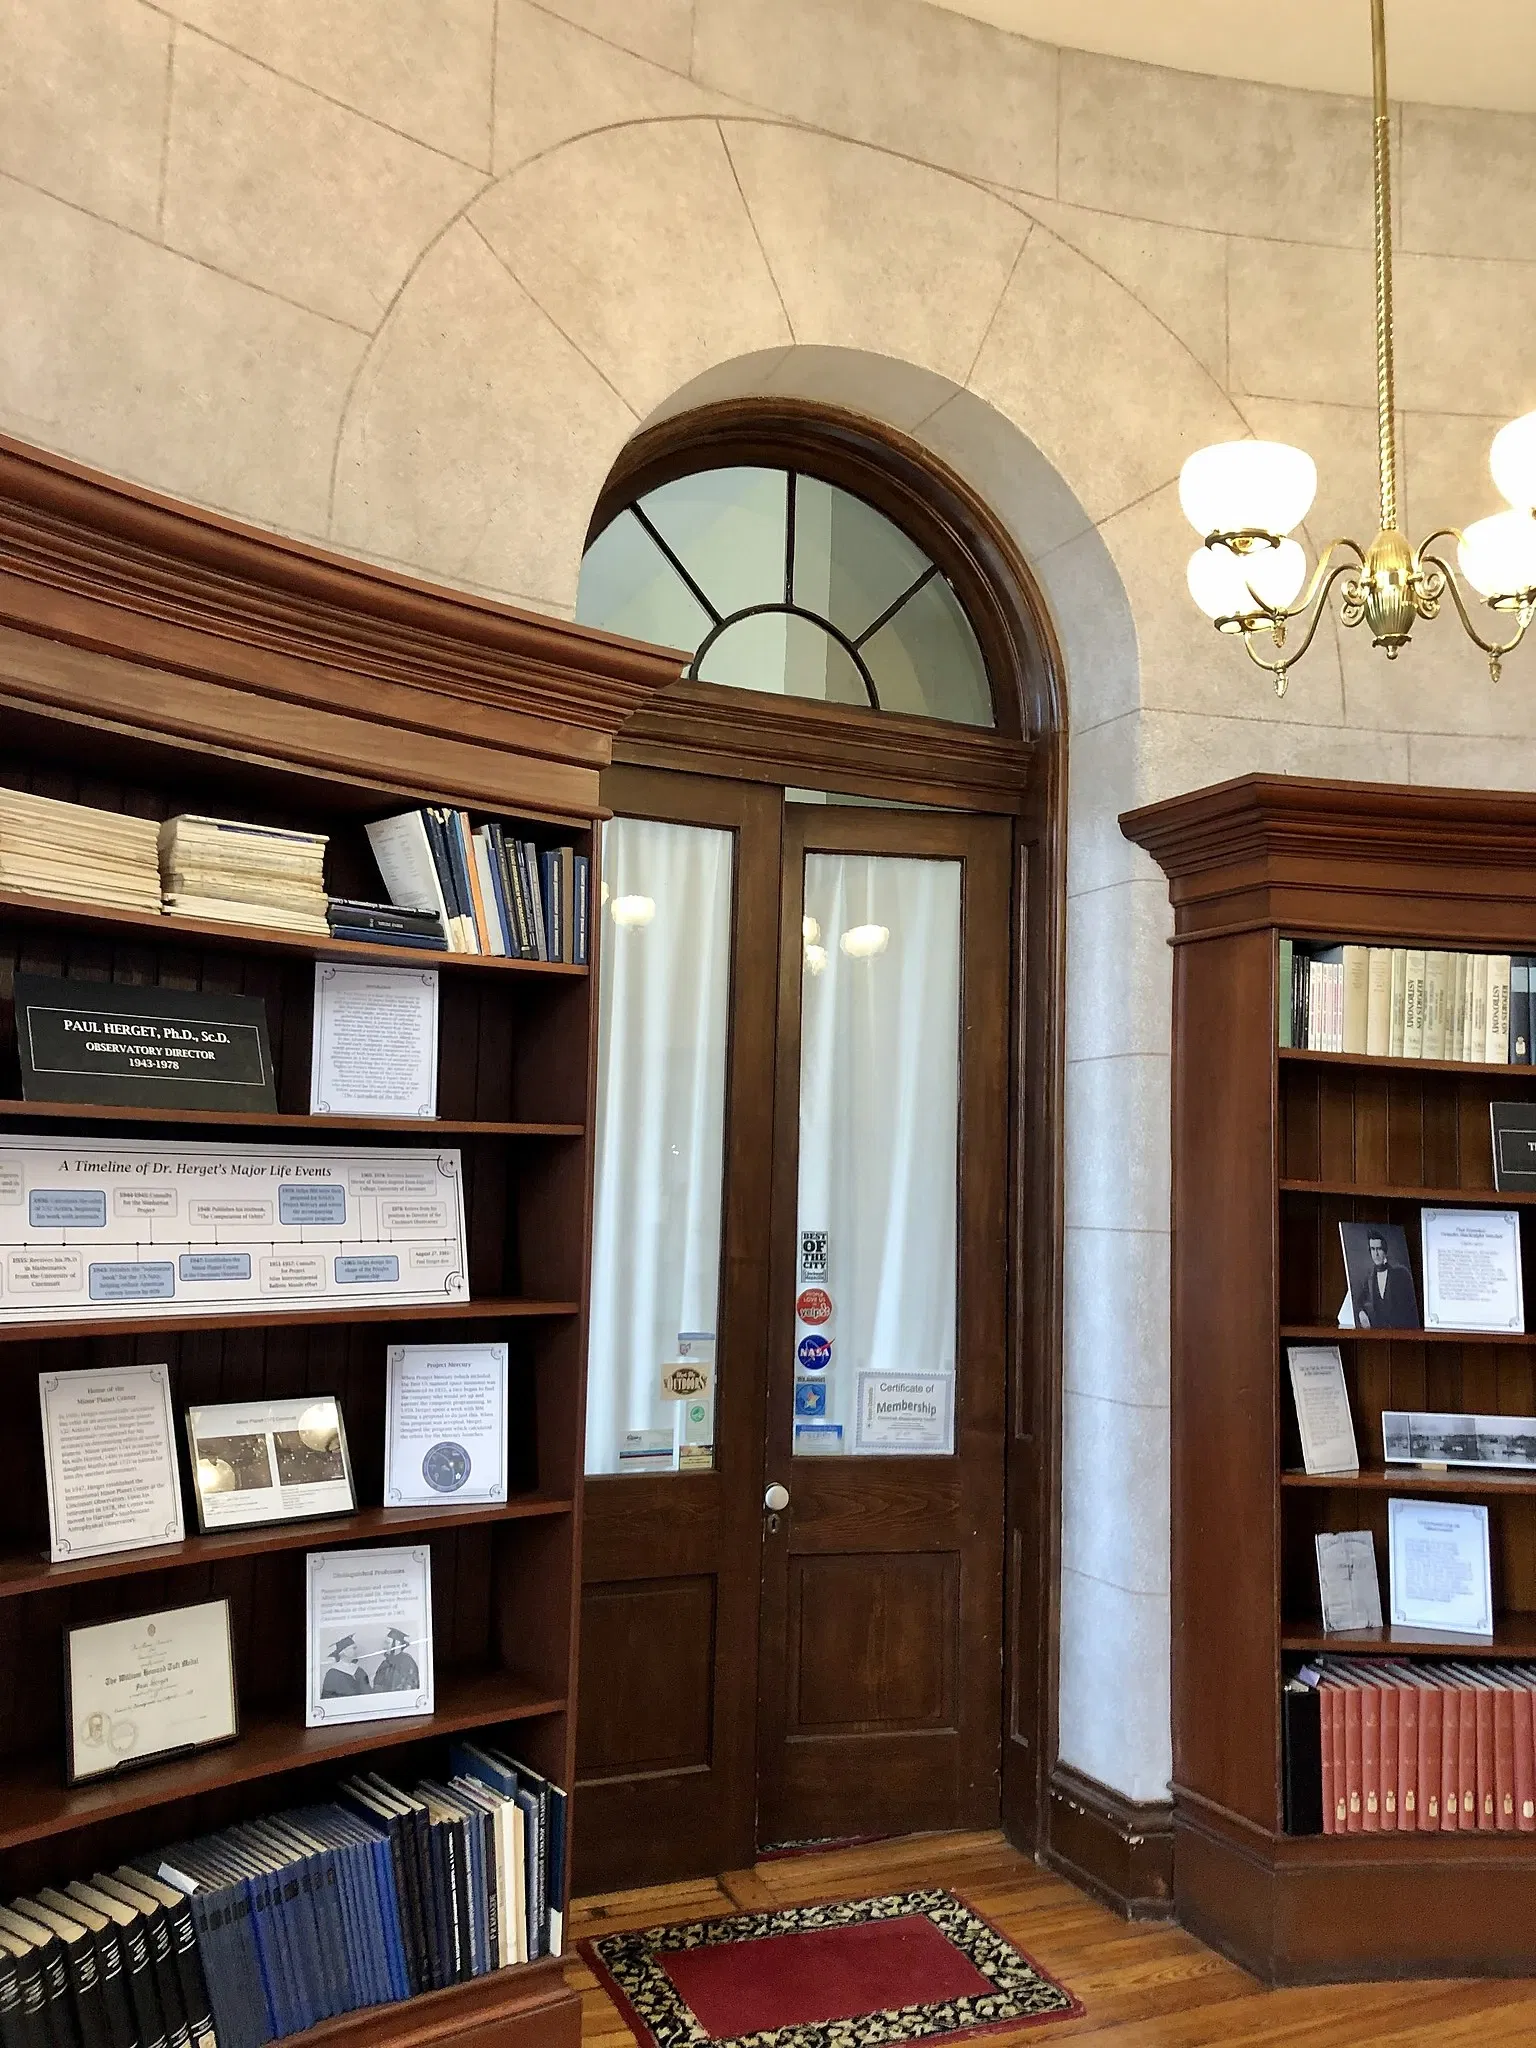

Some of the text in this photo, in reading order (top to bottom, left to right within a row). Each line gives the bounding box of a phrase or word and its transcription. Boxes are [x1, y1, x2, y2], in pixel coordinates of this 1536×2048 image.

[1492, 985, 1500, 1033] ASTRONOMY
[64, 1020, 230, 1043] PAUL HERGET, Ph.D., Sc.D.
[86, 1042, 215, 1060] OBSERVATORY DIRECTOR
[129, 1059, 179, 1070] 1943-1978
[1527, 1141, 1536, 1151] T
[58, 1160, 332, 1177] A Timeline of Dr. Herget's Major Life Events
[803, 1241, 826, 1252] OF
[803, 1253, 826, 1261] THE
[800, 1307, 821, 1319] yelp
[800, 1348, 829, 1357] NASA
[880, 1383, 934, 1393] Certificate of
[877, 1400, 936, 1416] Membership
